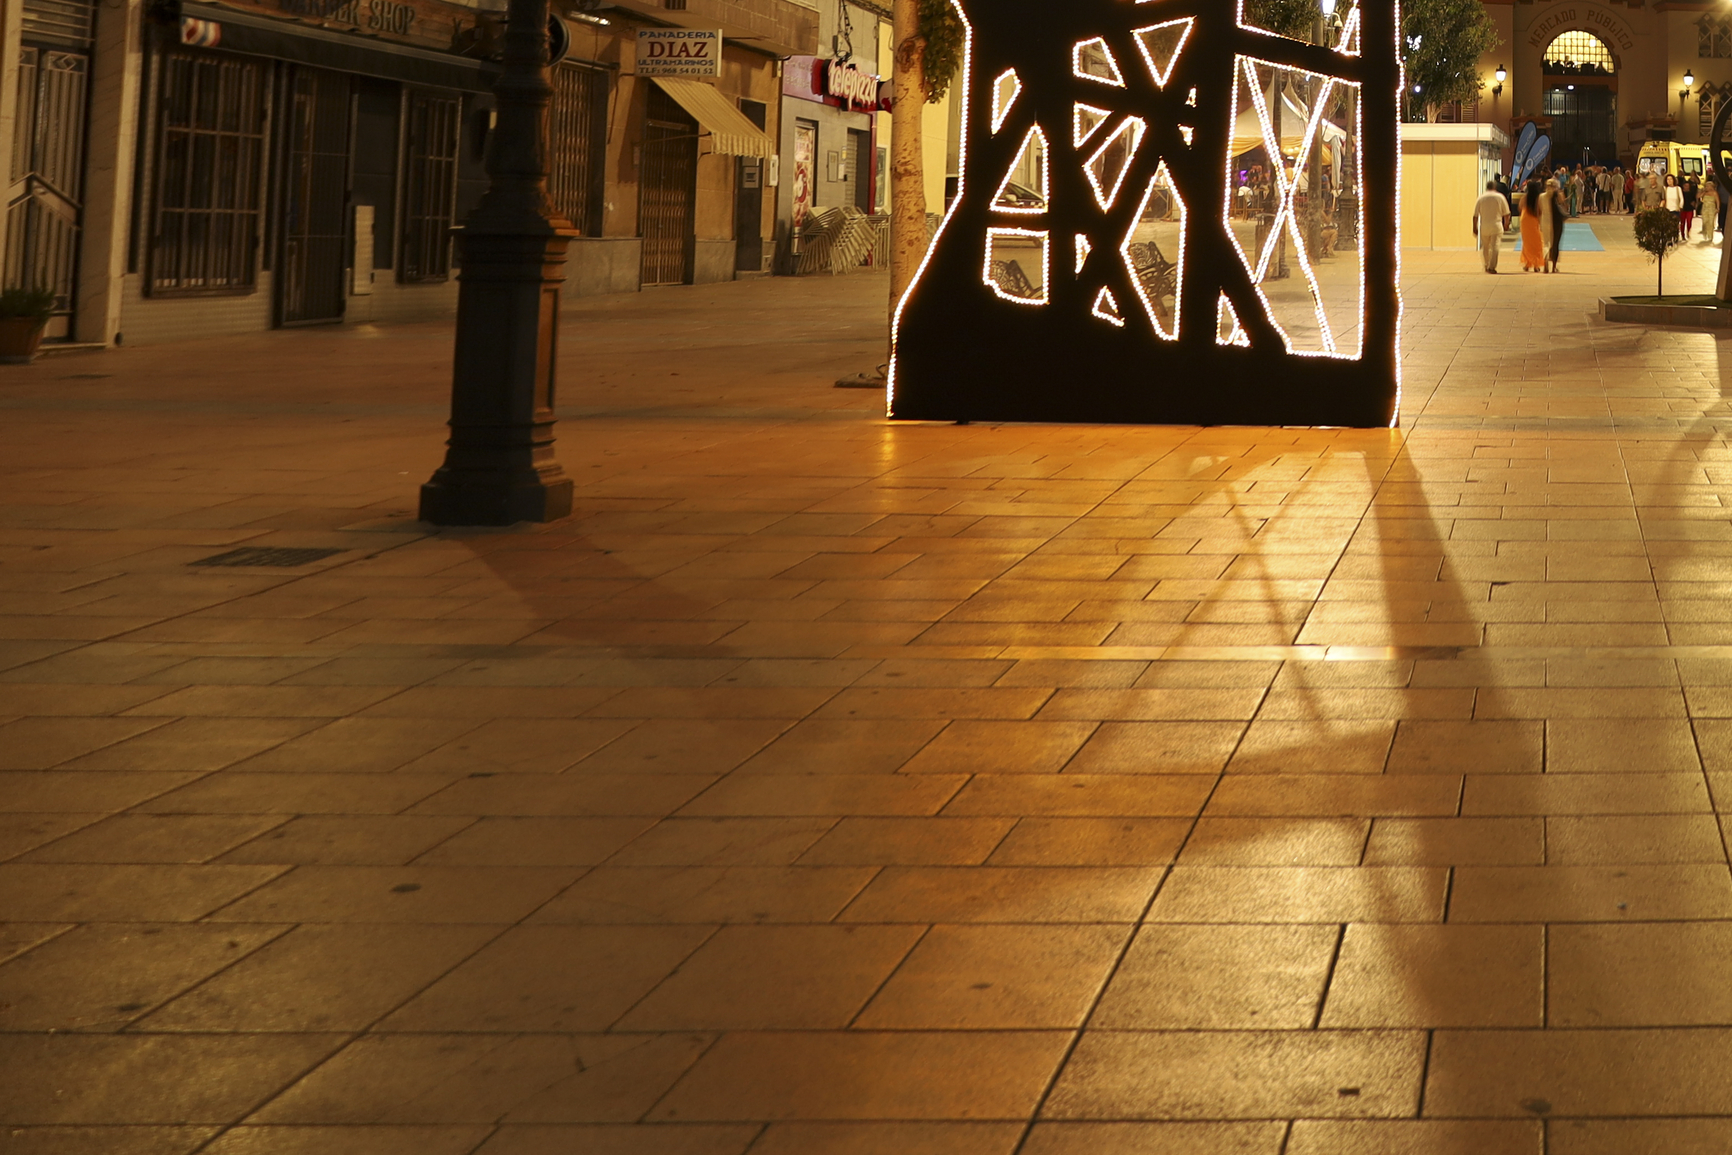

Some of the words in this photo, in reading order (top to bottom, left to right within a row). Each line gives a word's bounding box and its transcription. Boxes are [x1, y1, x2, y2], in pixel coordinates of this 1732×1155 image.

[638, 31, 716, 39] PANADERIA
[1528, 9, 1577, 48] MERCADO
[1586, 9, 1633, 50] PÚBLICO
[647, 41, 709, 58] DIAZ
[828, 57, 879, 112] telepizza
